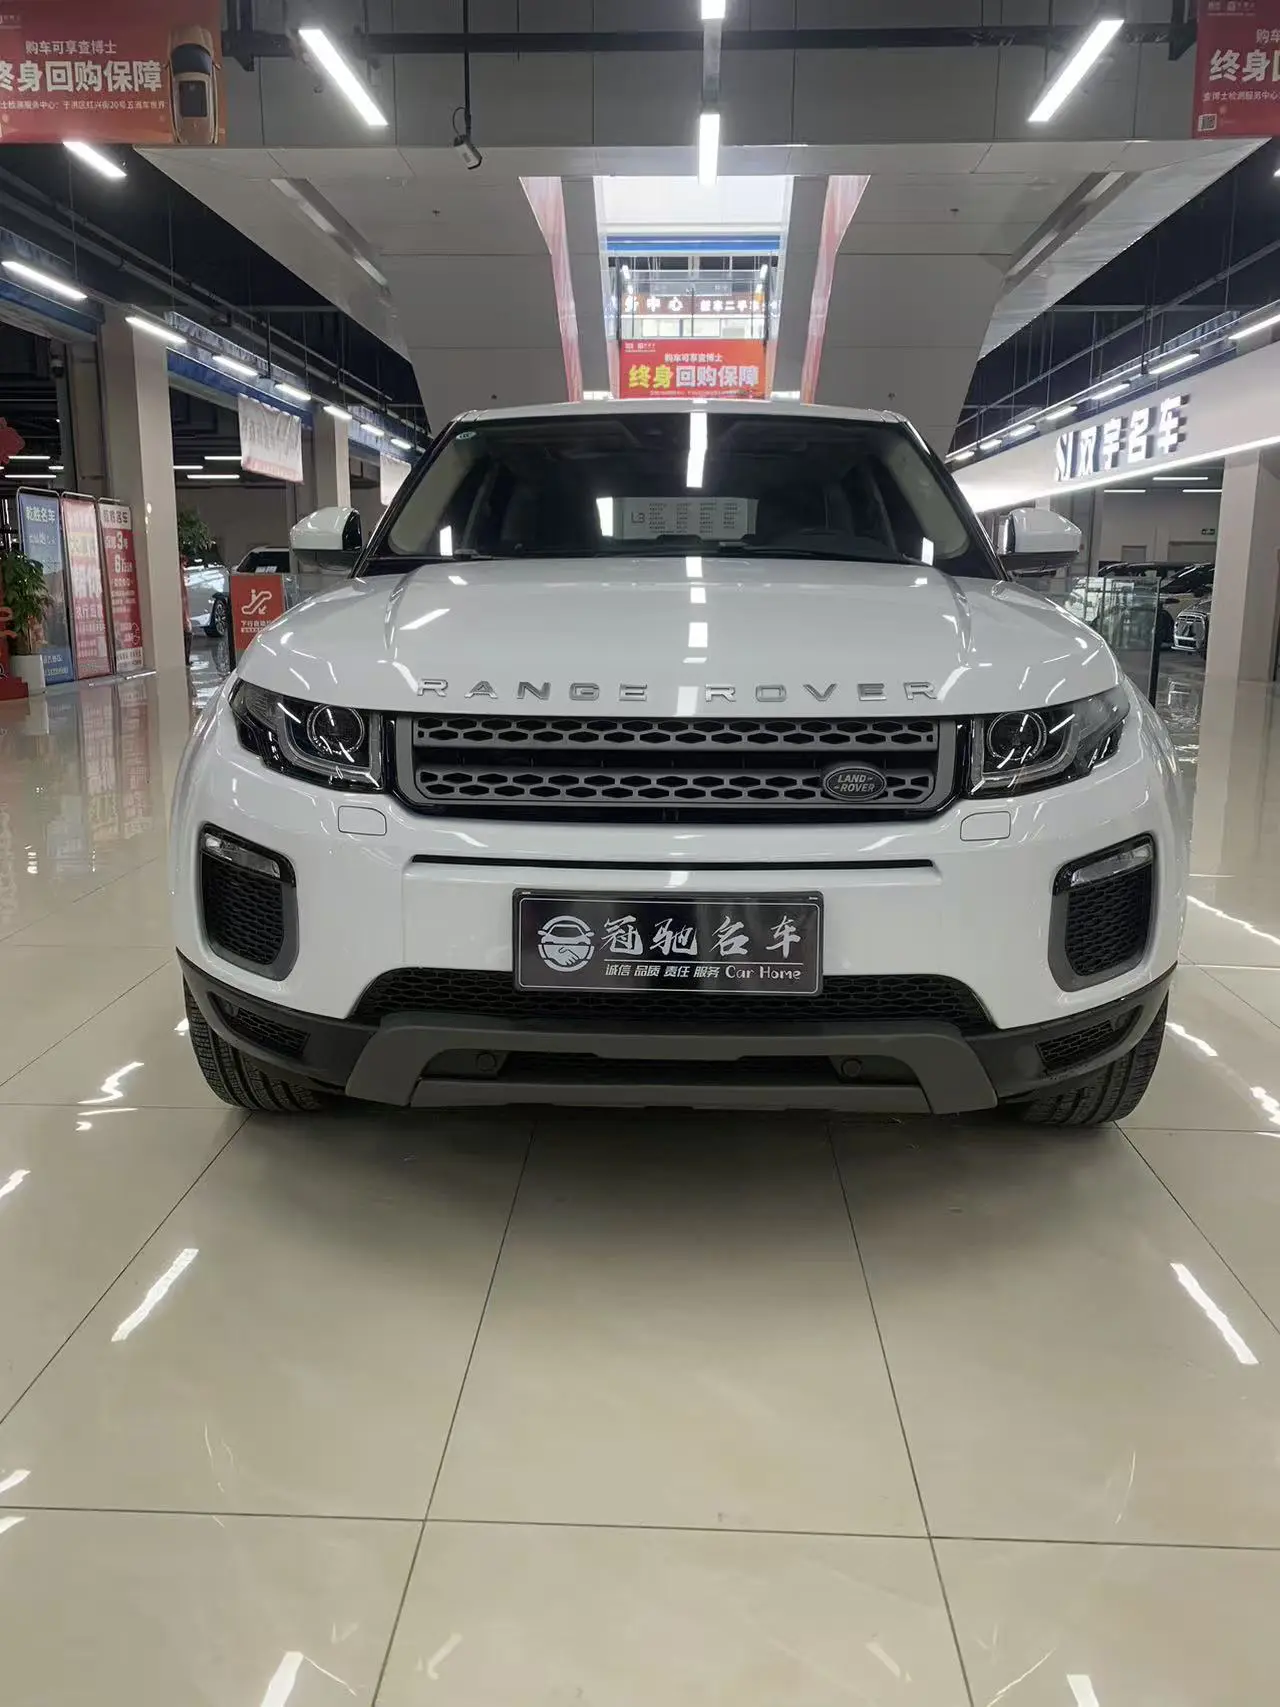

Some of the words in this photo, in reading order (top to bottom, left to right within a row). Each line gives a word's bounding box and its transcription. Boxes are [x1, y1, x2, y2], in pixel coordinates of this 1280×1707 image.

[25, 40, 117, 54] 购车可享查博士
[417, 678, 648, 701] RANGE
[705, 681, 938, 702] ROVER
[837, 774, 867, 783] LAND
[840, 783, 876, 792] ROVER
[601, 915, 802, 958] 冠驰名车
[605, 964, 631, 976] 诚信
[634, 965, 661, 977] 品质
[663, 966, 690, 978] 责任
[693, 966, 719, 978] 服务
[725, 965, 752, 979] Car
[759, 966, 801, 980] Home
